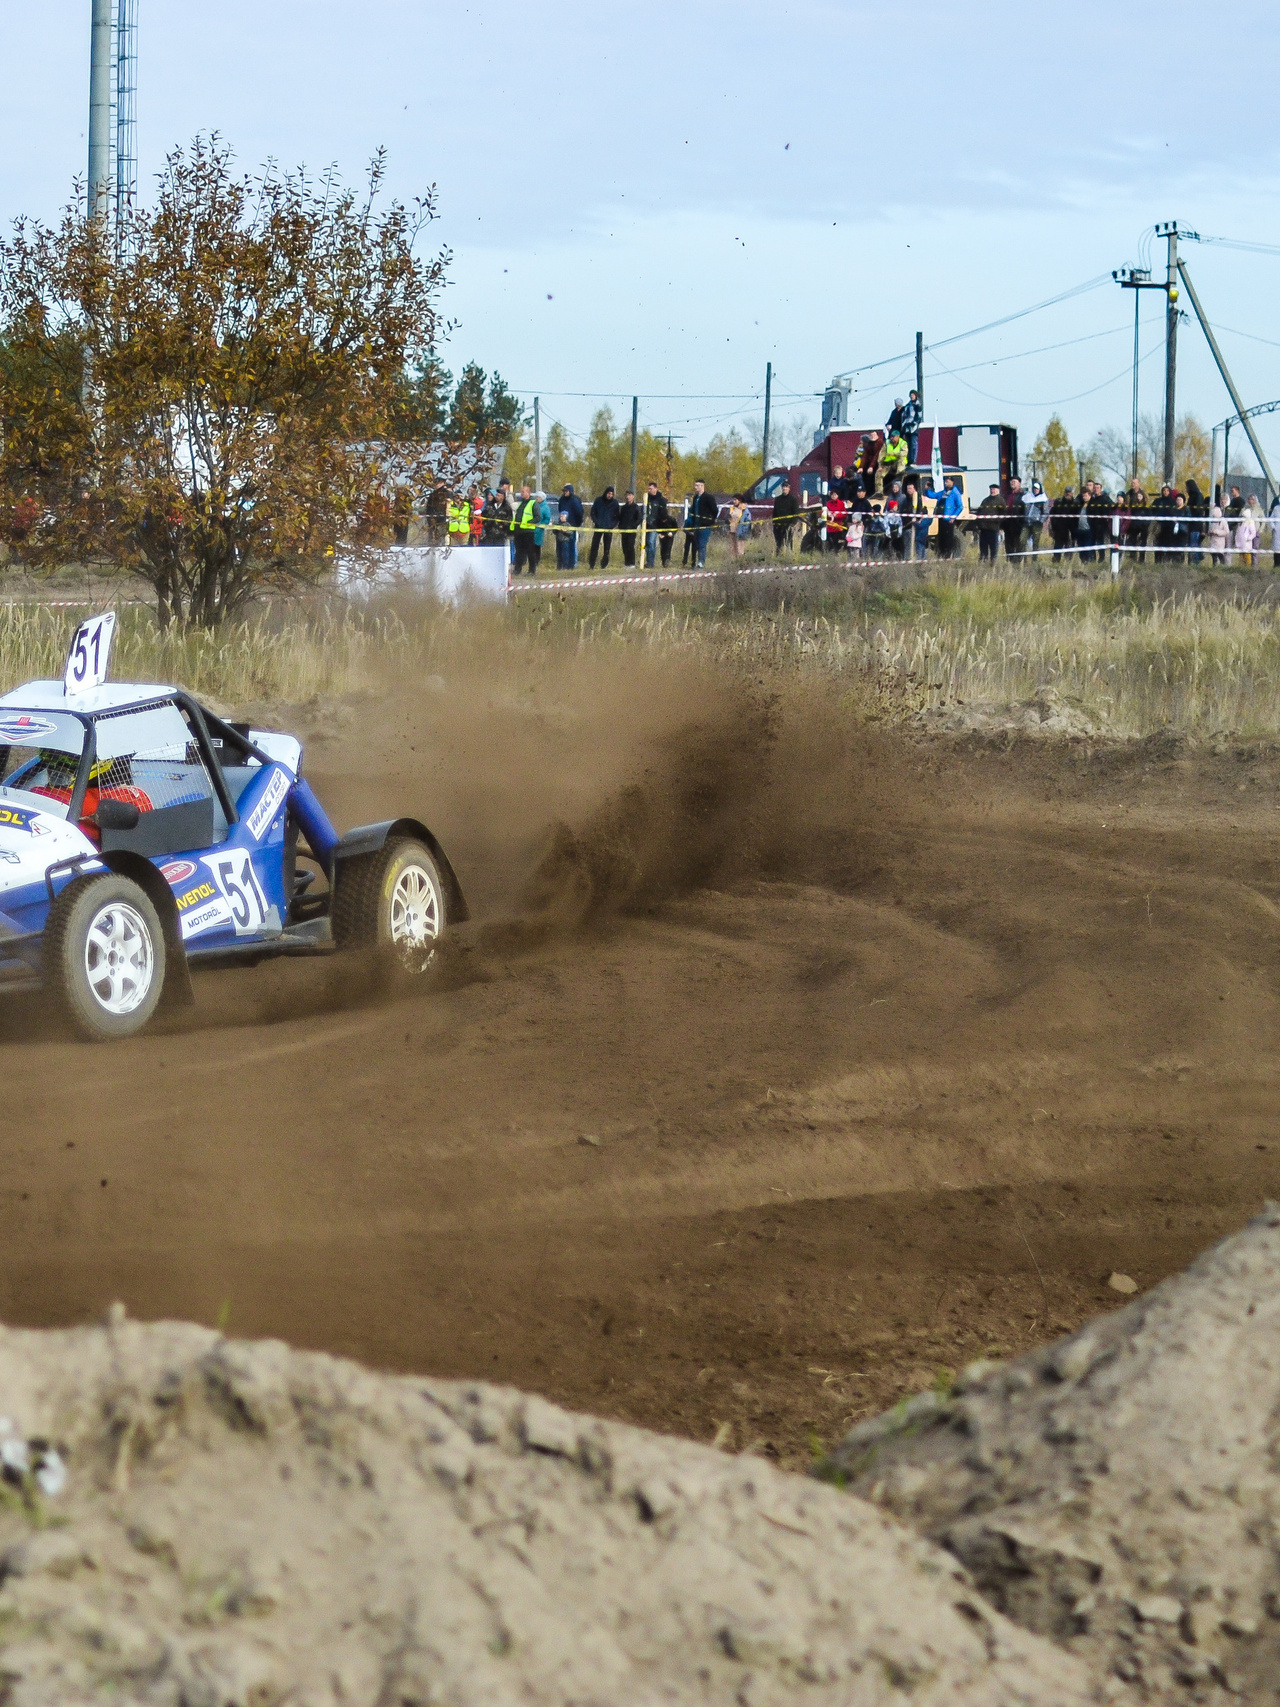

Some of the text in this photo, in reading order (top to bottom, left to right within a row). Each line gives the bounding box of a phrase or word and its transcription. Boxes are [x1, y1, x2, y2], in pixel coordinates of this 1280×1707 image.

[74, 621, 103, 682] 51
[187, 906, 222, 929] MOTORÖL
[218, 857, 266, 928] 51
